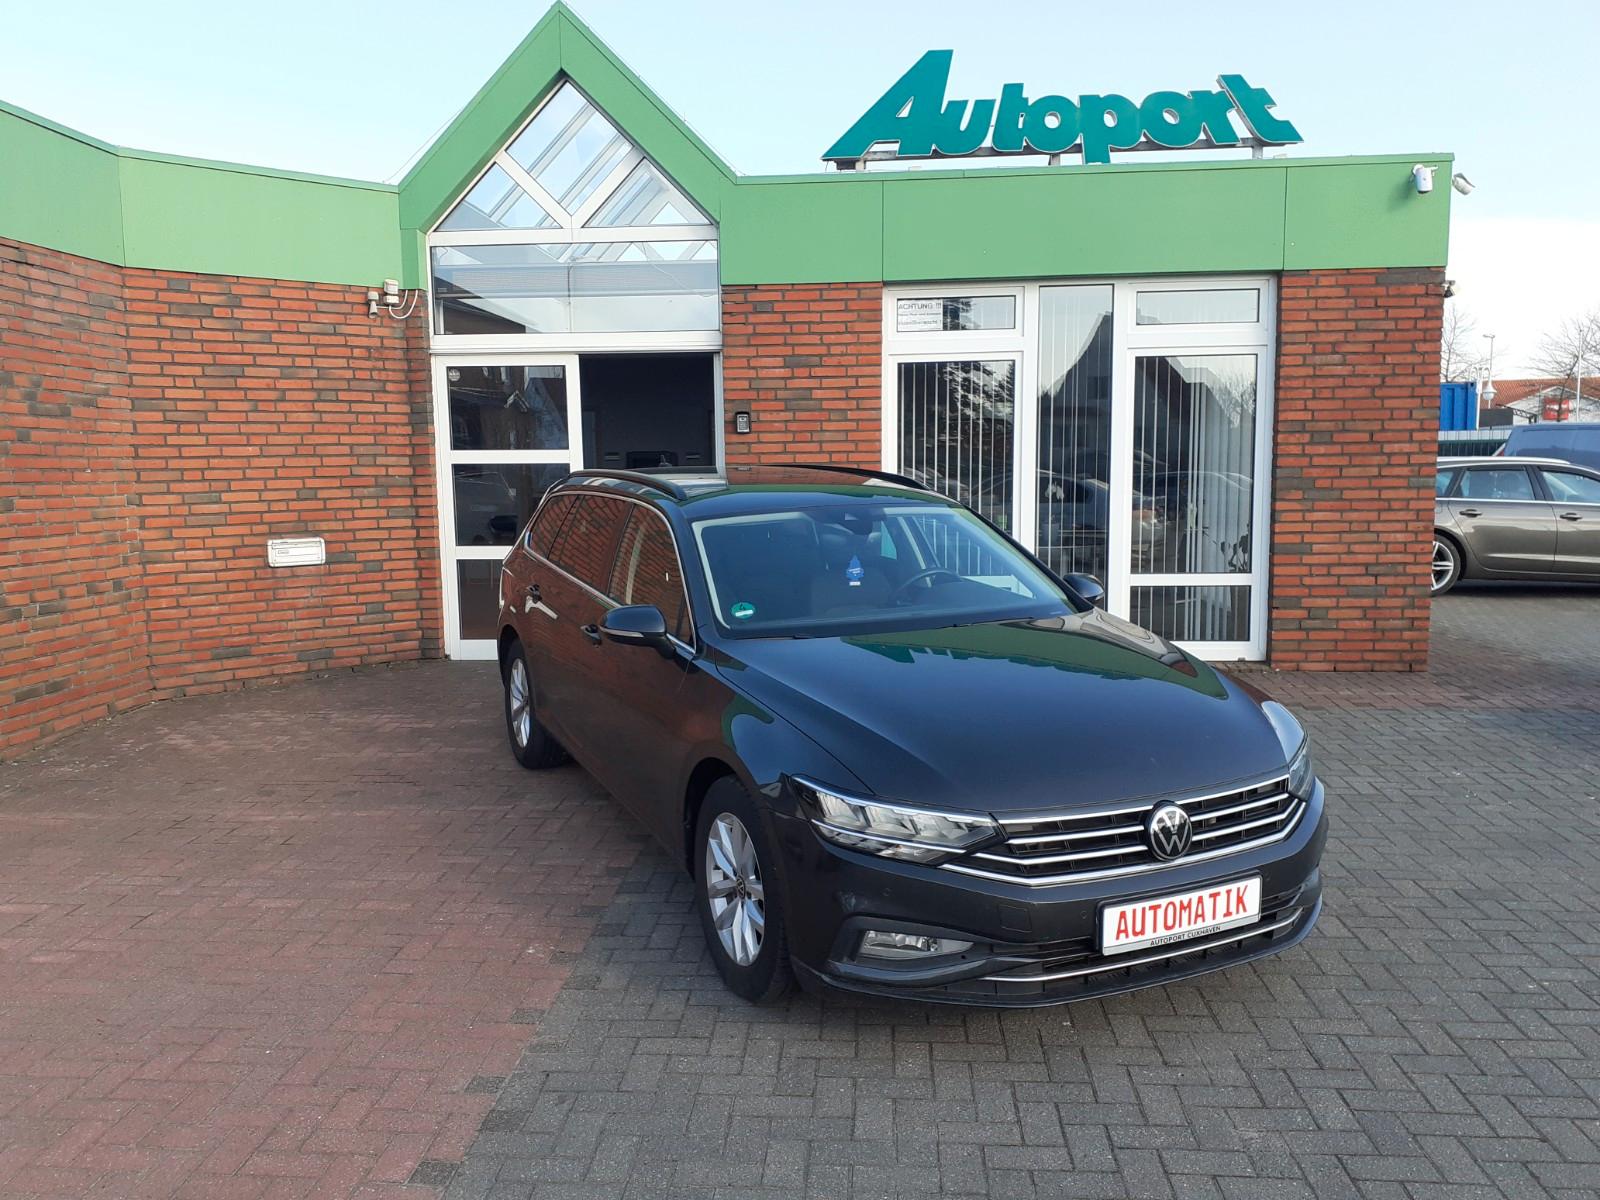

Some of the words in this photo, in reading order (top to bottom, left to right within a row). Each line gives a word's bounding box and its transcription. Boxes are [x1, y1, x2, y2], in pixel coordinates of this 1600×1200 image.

[822, 49, 1304, 164] Autoport
[1115, 884, 1249, 940] AUTOMATIK
[1150, 933, 1186, 946] AUTOPORT
[1187, 925, 1221, 939] CUXHAVEN
